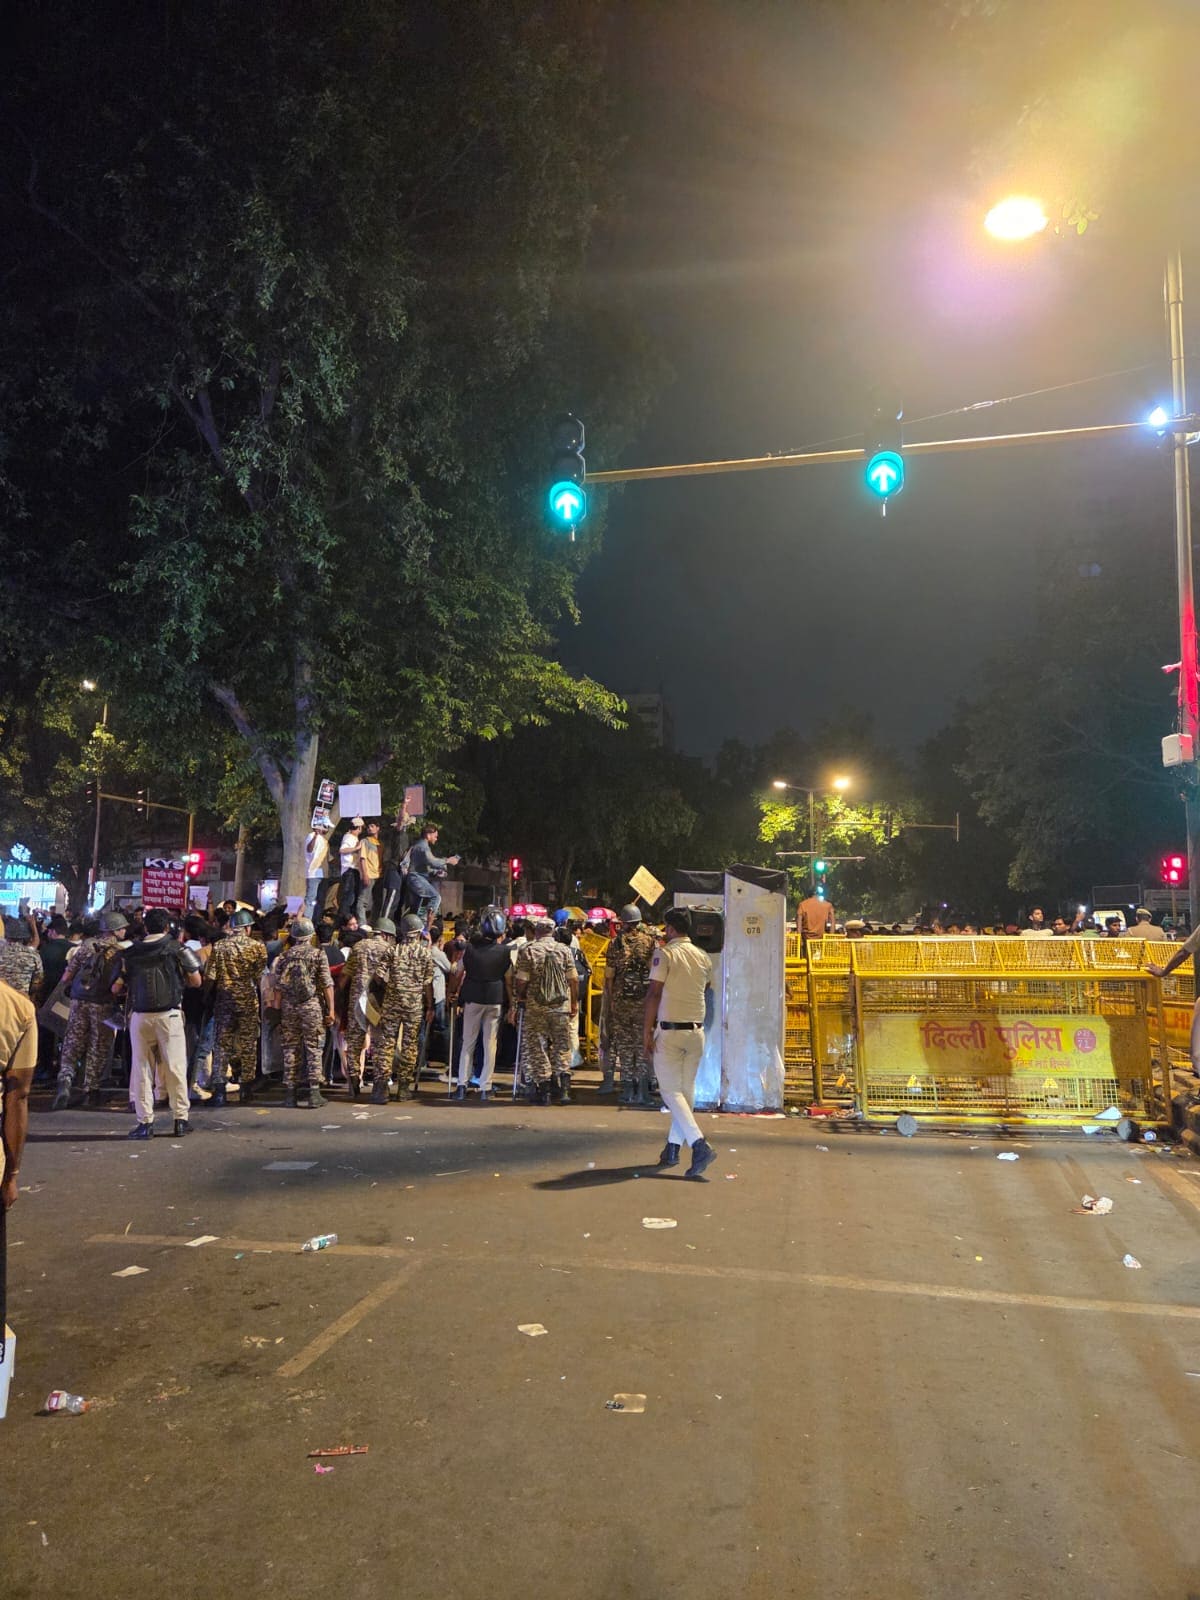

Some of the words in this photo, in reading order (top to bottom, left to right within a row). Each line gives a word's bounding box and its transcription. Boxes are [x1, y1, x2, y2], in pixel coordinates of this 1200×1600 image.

[145, 857, 185, 870] KYS
[920, 1020, 986, 1050] दिल्ली
[994, 1020, 1063, 1060] पुलिस
